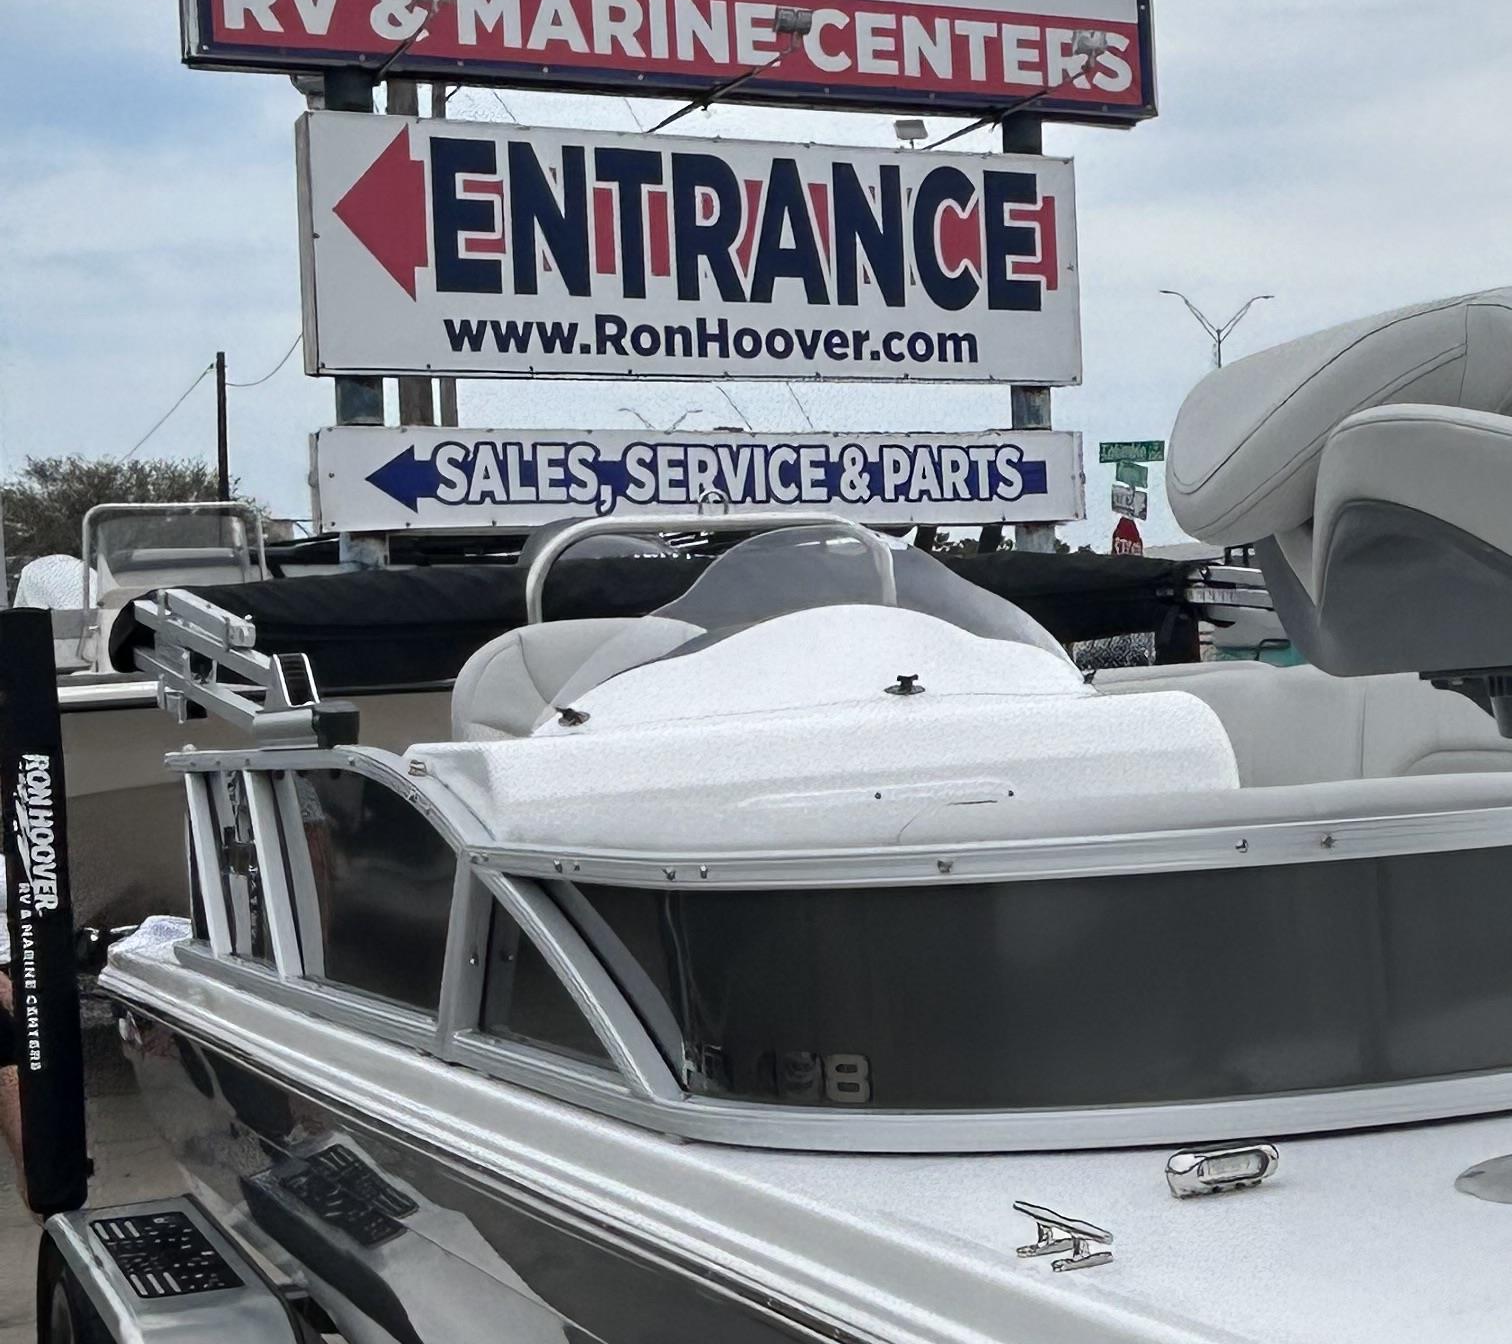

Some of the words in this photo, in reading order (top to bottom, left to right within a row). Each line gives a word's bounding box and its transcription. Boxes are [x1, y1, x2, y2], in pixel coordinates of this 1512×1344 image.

[803, 7, 1133, 93] CENTERS
[429, 135, 1043, 313] ENTRANCE
[444, 314, 979, 365] www.RonHoover.com
[432, 442, 617, 515] SALES,
[622, 442, 830, 504] SERVICE
[838, 443, 874, 503] &
[880, 444, 1025, 502] PARTS
[22, 754, 53, 806] RON
[28, 807, 59, 913] HOOVER
